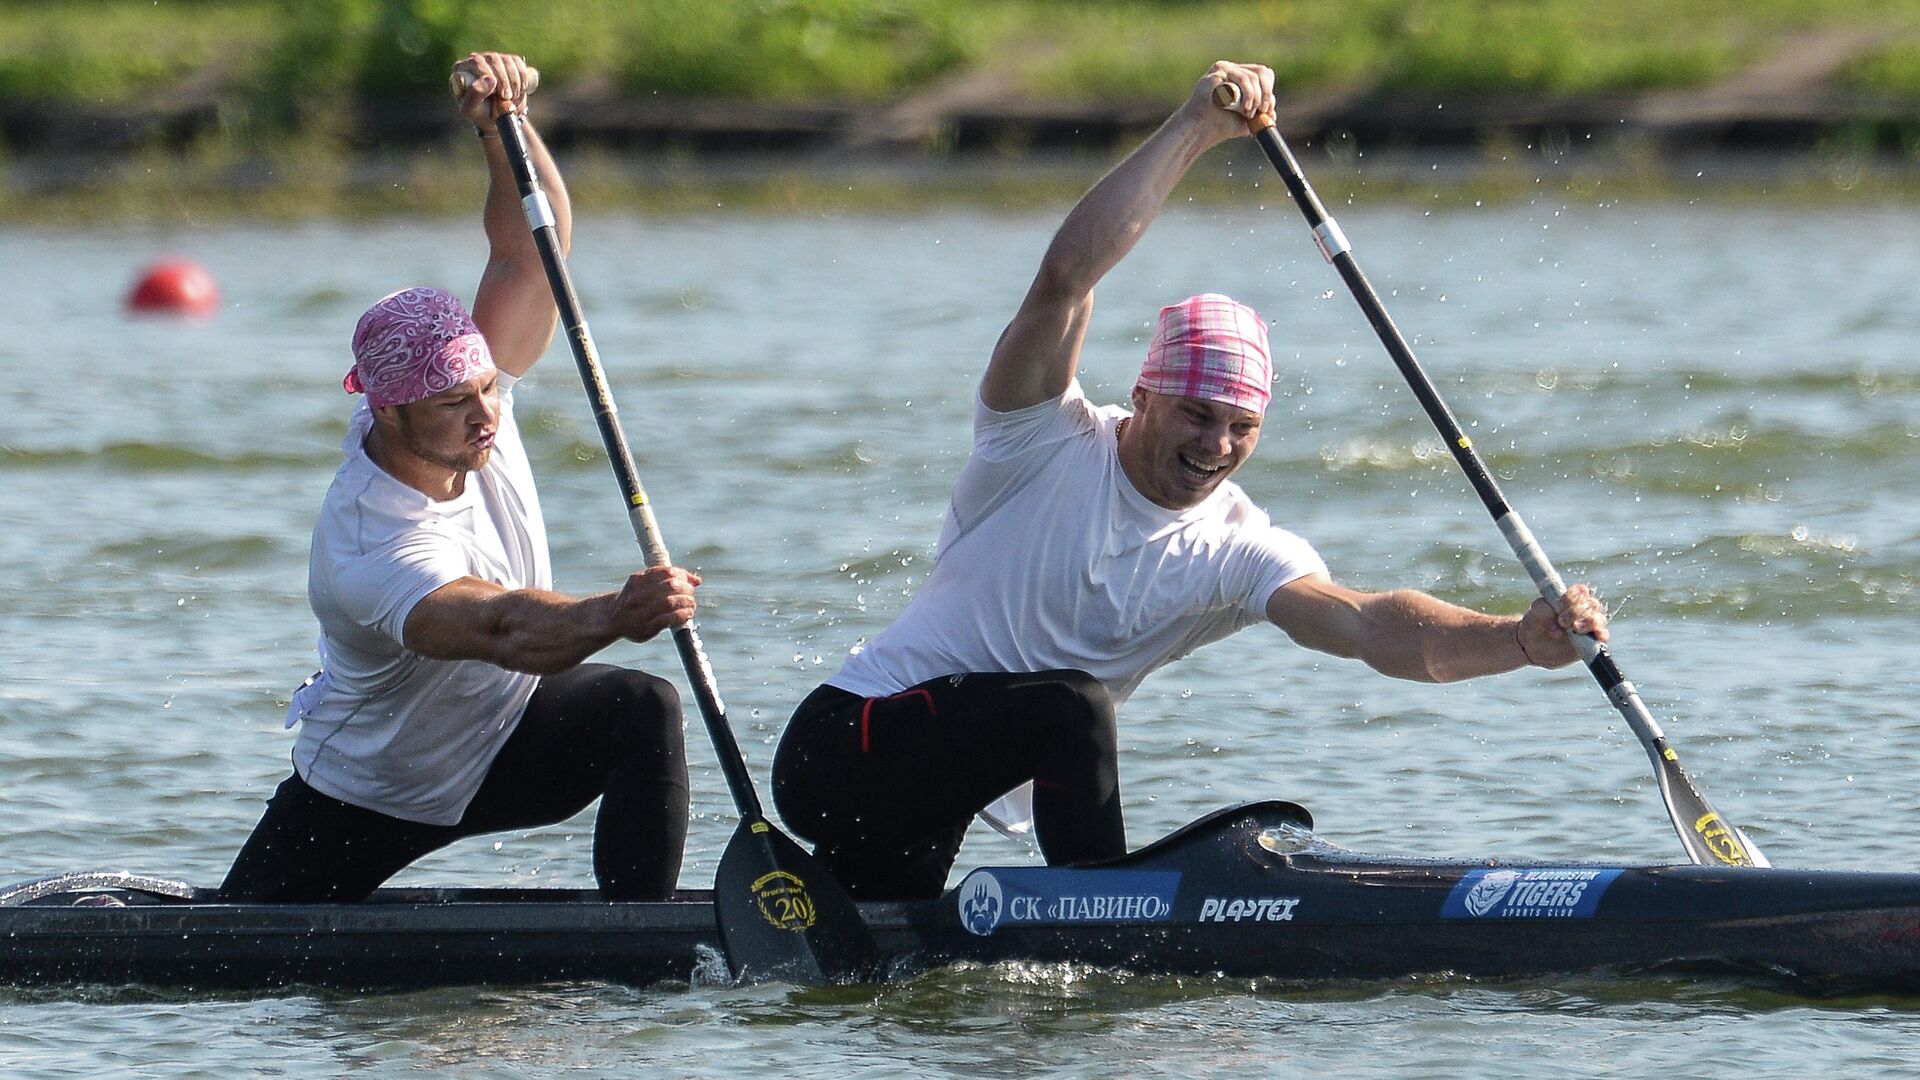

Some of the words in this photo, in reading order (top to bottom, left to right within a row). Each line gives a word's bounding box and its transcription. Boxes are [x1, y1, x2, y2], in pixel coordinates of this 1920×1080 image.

[1507, 882, 1588, 907] TIGERS
[775, 897, 808, 921] 20
[1009, 897, 1042, 921] СК
[1047, 896, 1171, 920] «ПАВИНО»
[1198, 898, 1301, 923] PLASTEX
[1502, 908, 1542, 917] SPORTS
[1547, 908, 1574, 917] CLUB
